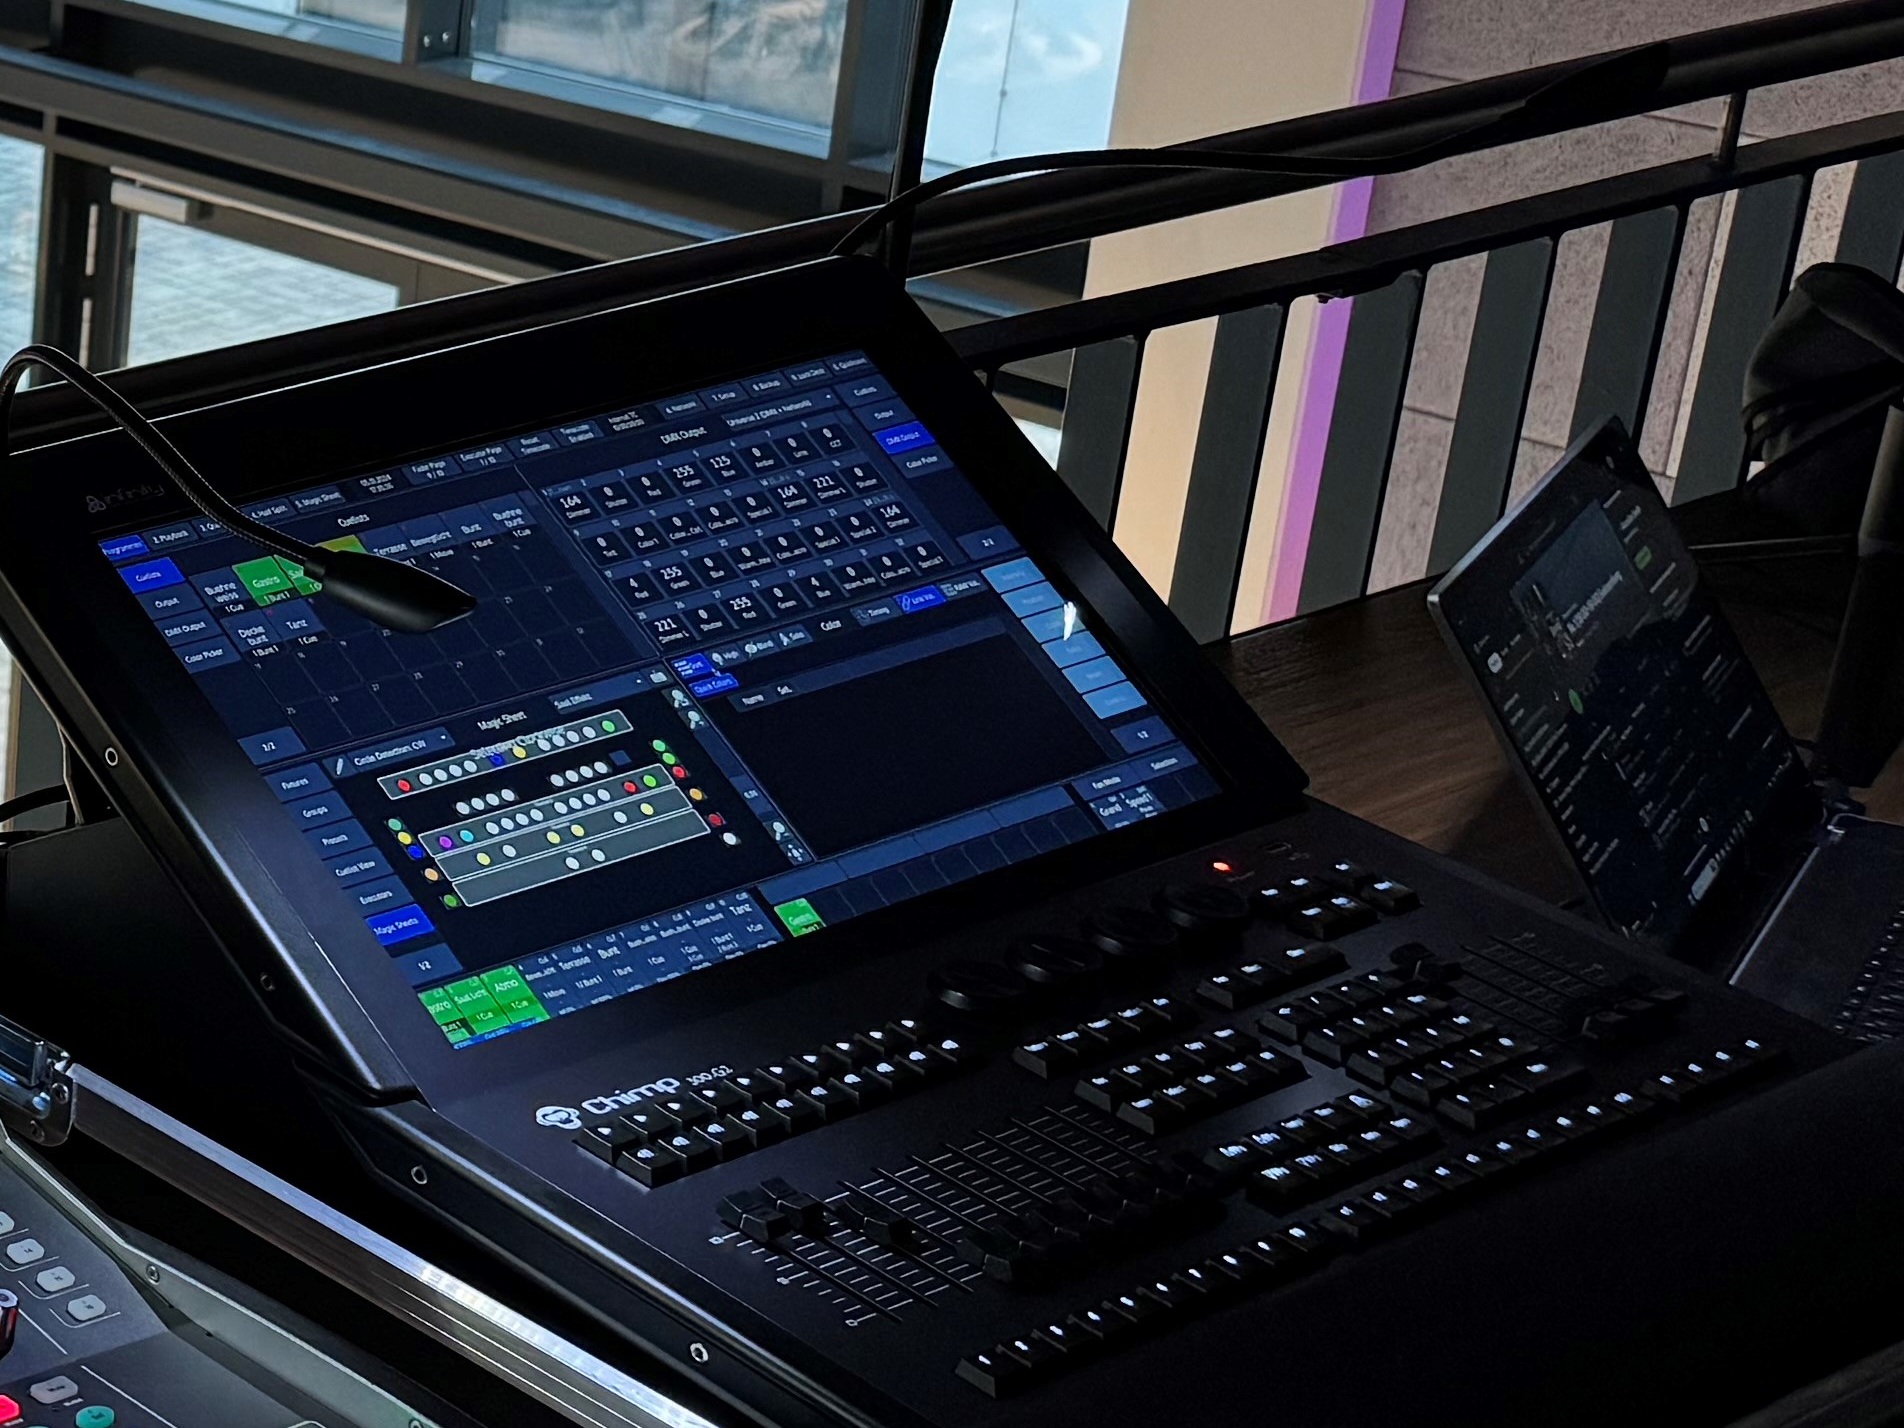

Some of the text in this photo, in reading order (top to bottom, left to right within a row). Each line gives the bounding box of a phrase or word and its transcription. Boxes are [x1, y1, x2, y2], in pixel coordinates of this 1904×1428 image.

[709, 455, 731, 469] 125
[672, 464, 695, 479] 255
[659, 565, 683, 580] 255
[728, 596, 753, 611] 255
[581, 1077, 682, 1115] Chimp
